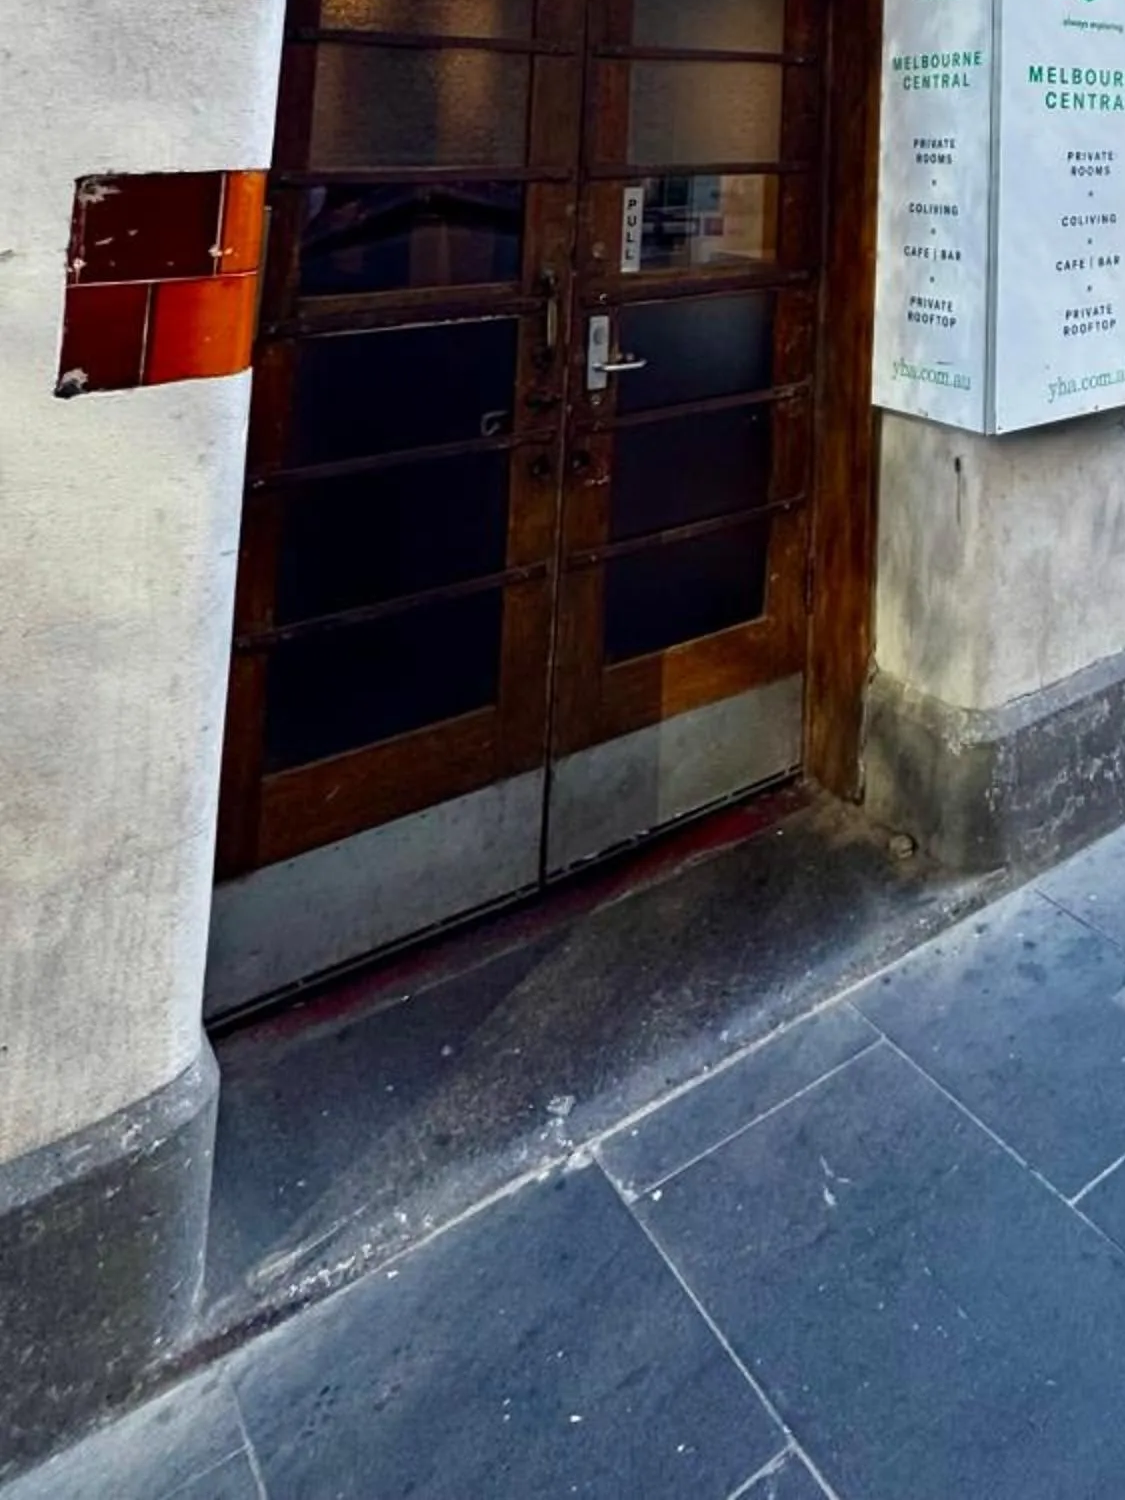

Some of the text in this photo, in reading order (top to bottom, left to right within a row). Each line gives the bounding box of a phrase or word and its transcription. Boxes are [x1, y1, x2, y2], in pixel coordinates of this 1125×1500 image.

[893, 51, 983, 71] MELBOURNE
[903, 72, 970, 91] CENTRAL
[913, 138, 956, 150] PRIVATE
[915, 153, 953, 165] ROOMS
[1067, 151, 1114, 162] PRIVATE
[1070, 166, 1111, 177] ROOMS
[908, 202, 959, 217] COLIVING
[1061, 213, 1117, 228] COLIVING
[625, 198, 637, 261] PULL
[903, 245, 929, 259] CAFE
[941, 249, 962, 262] BAR
[1055, 257, 1085, 271] CAFE
[1098, 255, 1121, 268] BAR
[909, 295, 954, 313] PRIVATE
[1065, 302, 1113, 321] PRIVATE
[907, 311, 957, 329] ROOFTOP
[1062, 318, 1117, 337] ROOFTOP
[892, 357, 972, 391] yha.com.au
